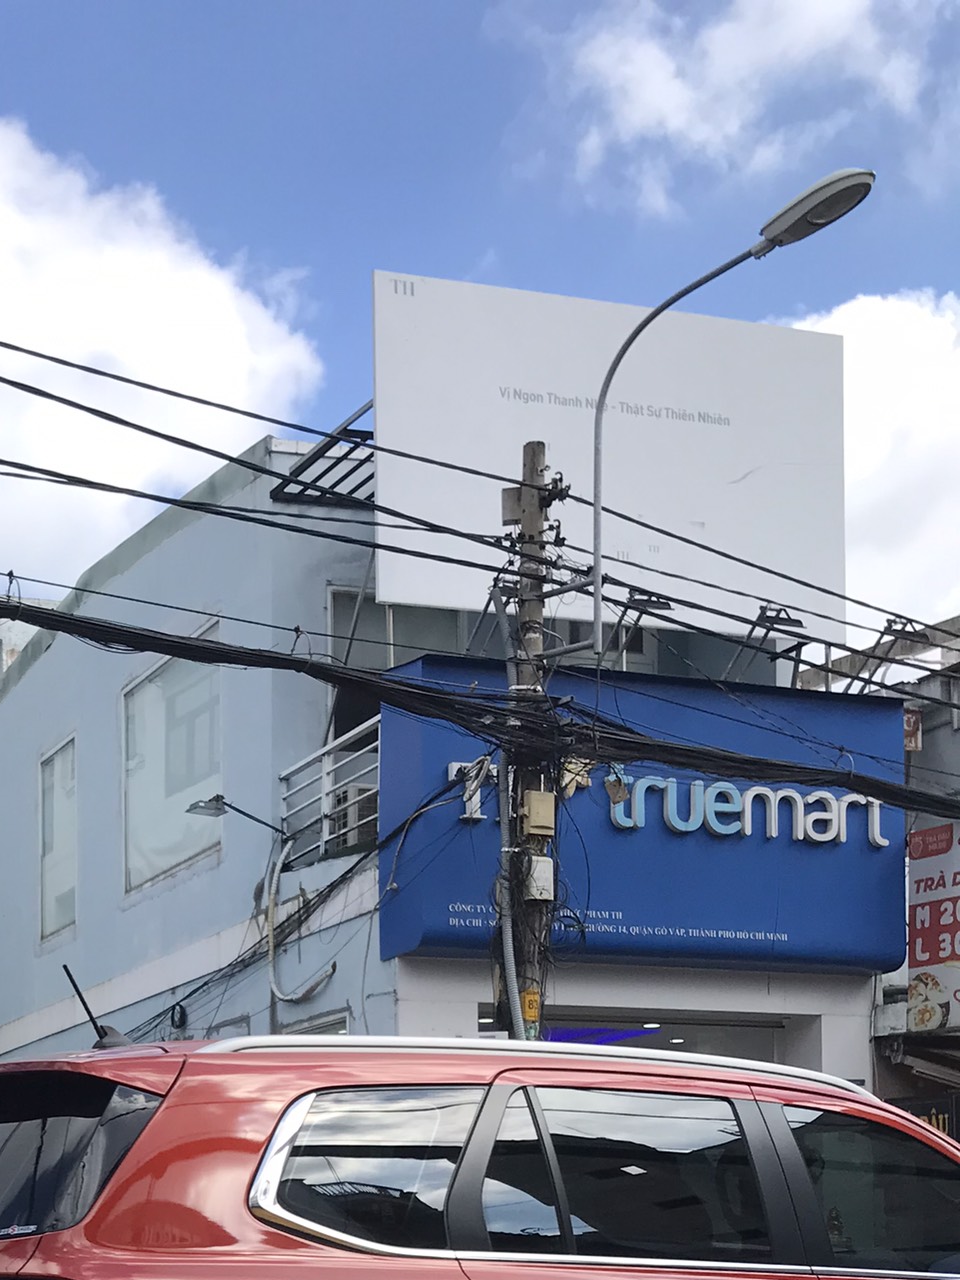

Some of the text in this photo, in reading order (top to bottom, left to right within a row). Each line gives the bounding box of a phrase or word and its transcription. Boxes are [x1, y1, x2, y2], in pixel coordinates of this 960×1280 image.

[499, 386, 511, 401] Vị
[513, 388, 544, 405] Ngon
[546, 391, 582, 409] Thanh
[664, 406, 695, 423] Thiên
[697, 410, 730, 427] Nhiên
[913, 870, 946, 895] TRÀ
[448, 902, 476, 914] CÔNG
[611, 911, 623, 920] TH
[916, 905, 930, 929] M
[630, 924, 653, 937] QUẬN
[654, 925, 668, 936] GÒ
[688, 928, 717, 940] THÀNH
[767, 931, 788, 942] MINH
[915, 937, 929, 961] L
